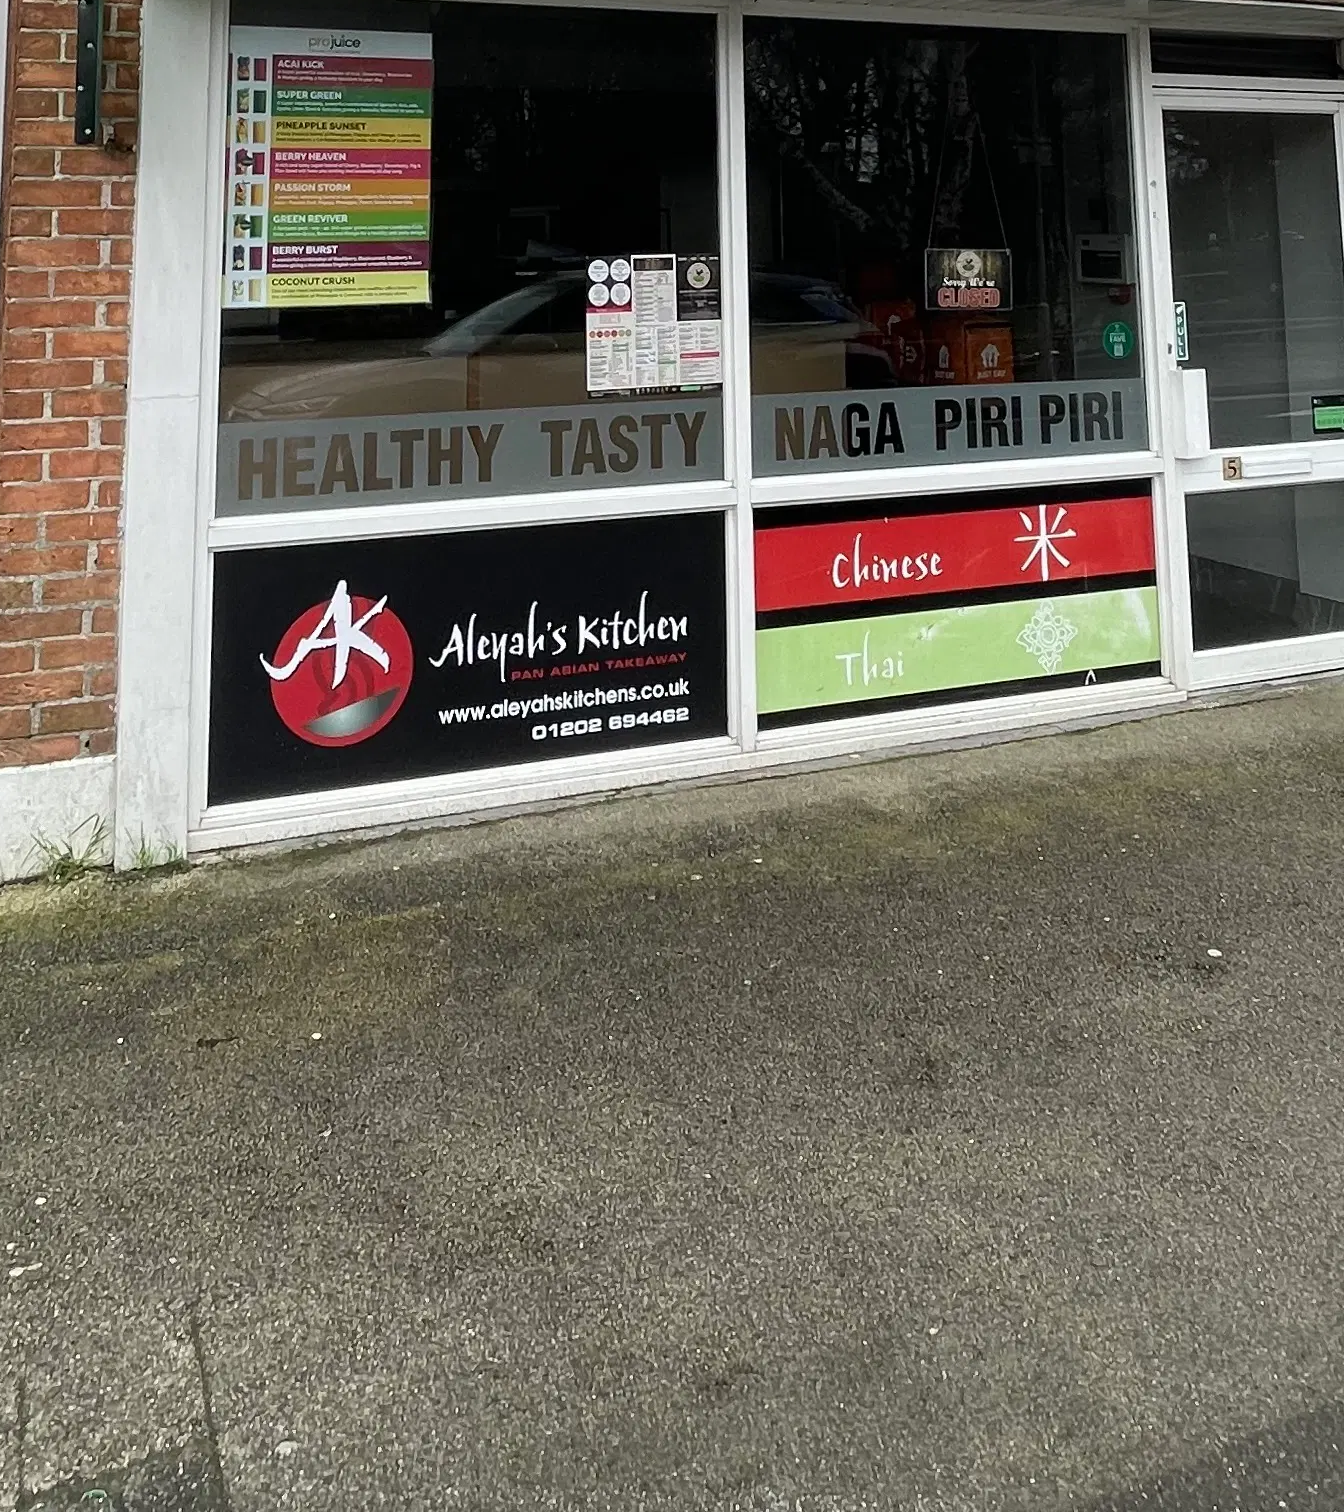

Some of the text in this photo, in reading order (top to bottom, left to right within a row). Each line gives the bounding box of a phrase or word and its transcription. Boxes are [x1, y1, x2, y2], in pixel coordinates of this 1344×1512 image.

[308, 34, 361, 50] projuice
[302, 61, 324, 69] KICK
[277, 91, 342, 100] SUPER GREEN
[276, 121, 367, 131] PINEAPPLE SUNSET
[275, 152, 347, 161] BERRY HEAVEN
[274, 183, 351, 192] PASSION STORM
[273, 214, 348, 223] GREEN REVIVER
[272, 245, 339, 255] BERRY BURST
[272, 277, 355, 286] COCONUT CRUSH
[937, 288, 1000, 308] CLOSED
[1176, 316, 1185, 356] PULL
[775, 391, 1124, 461] NAGA PIRI PIRI
[238, 411, 707, 501] HEALTHY TASTY
[1227, 460, 1237, 478] 5
[1013, 504, 1076, 581] 米
[831, 532, 943, 588] Chinese
[259, 579, 390, 689] AK
[429, 590, 687, 683] Aleyah's Kitchen
[511, 652, 687, 682] PAN ASIAN TAKEAWAY
[835, 630, 905, 687] Thai
[438, 676, 690, 725] www.aleyahskitchens.co.uk
[531, 706, 689, 741] 01202 694462
